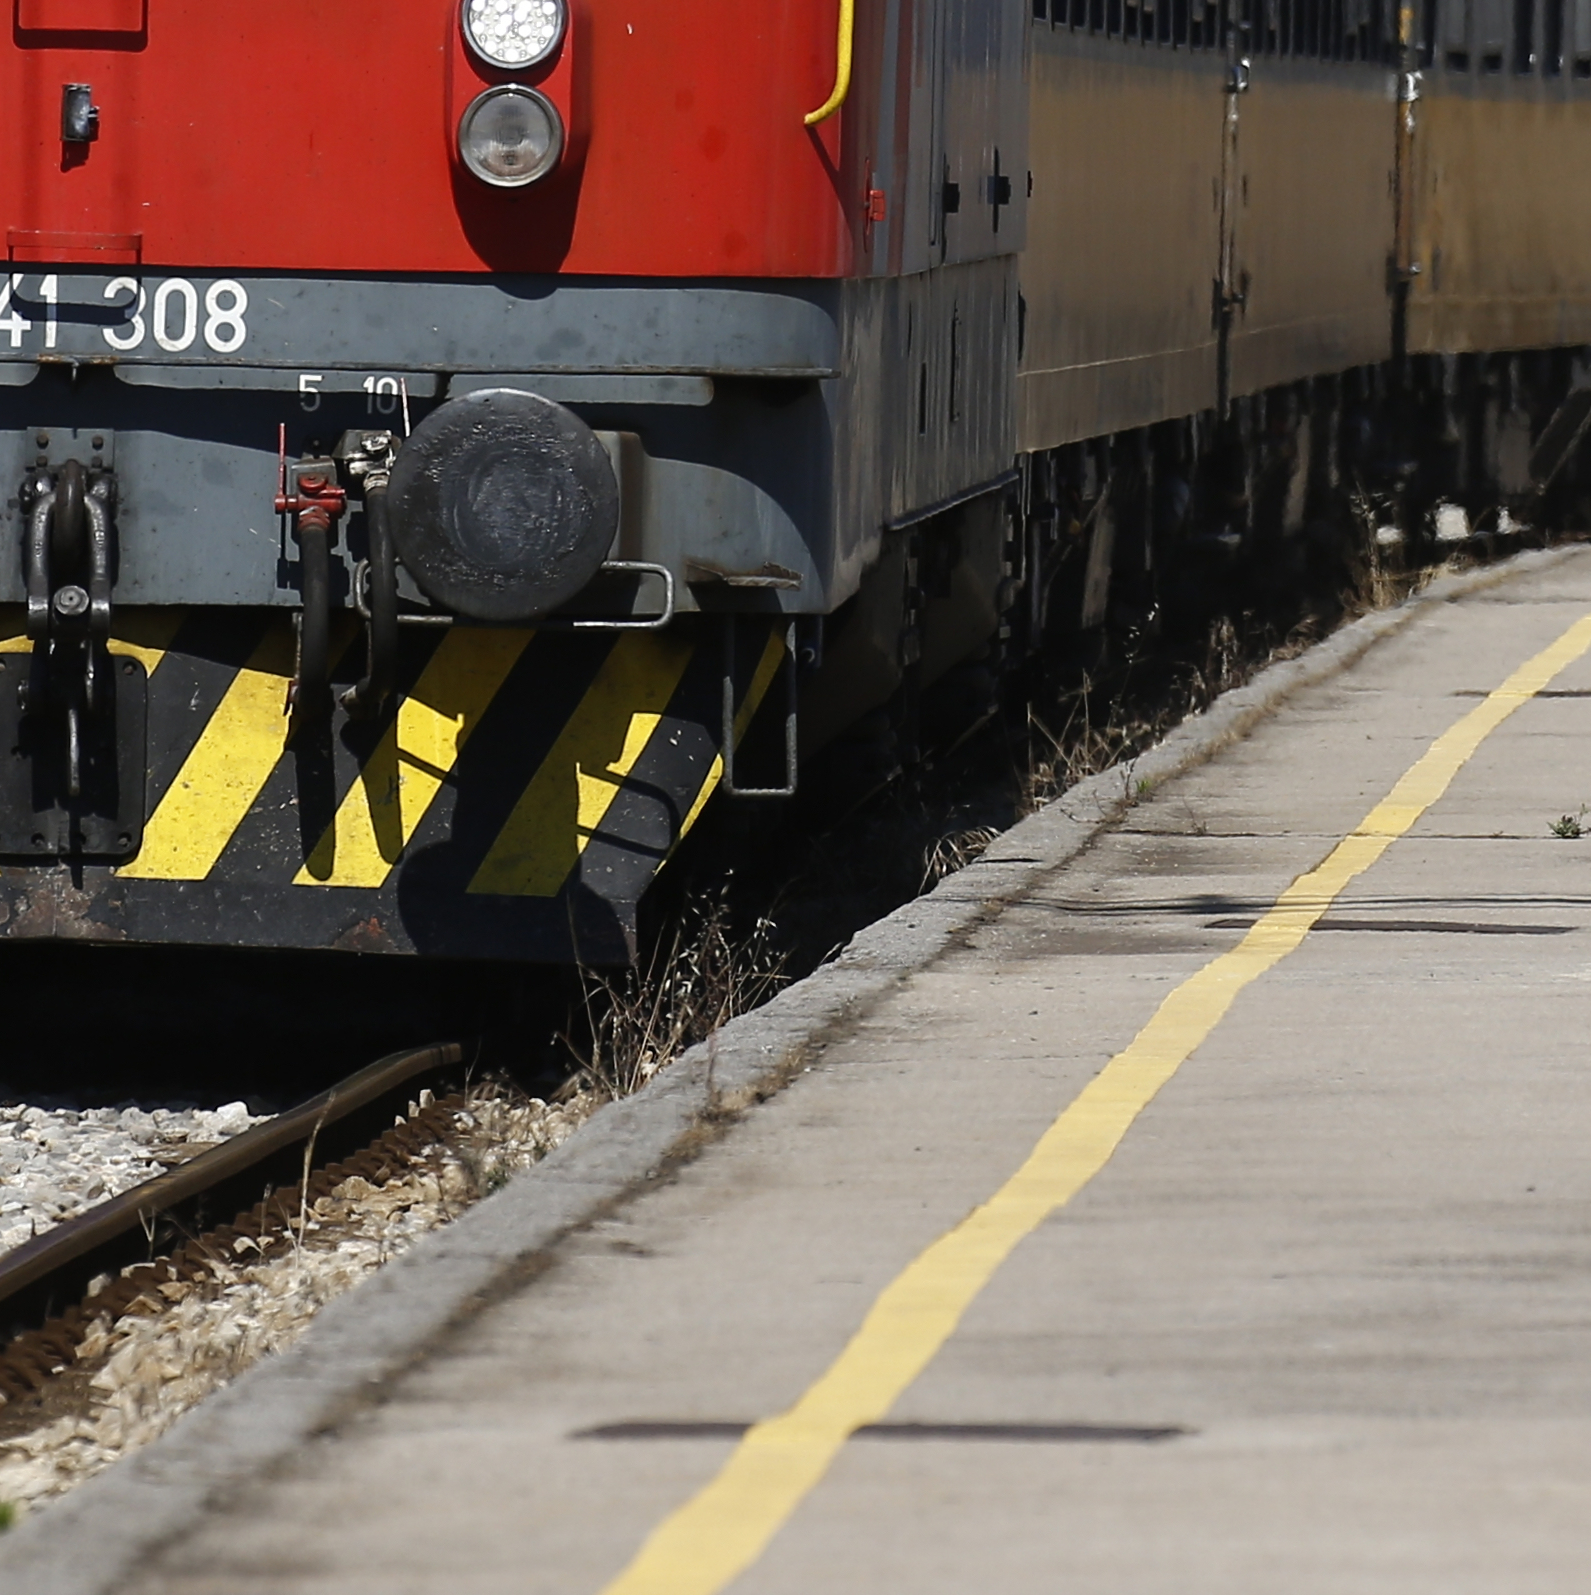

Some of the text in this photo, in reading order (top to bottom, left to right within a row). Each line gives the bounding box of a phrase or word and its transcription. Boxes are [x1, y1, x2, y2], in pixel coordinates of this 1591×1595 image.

[103, 276, 248, 353] 308
[299, 374, 398, 414] 5 10
